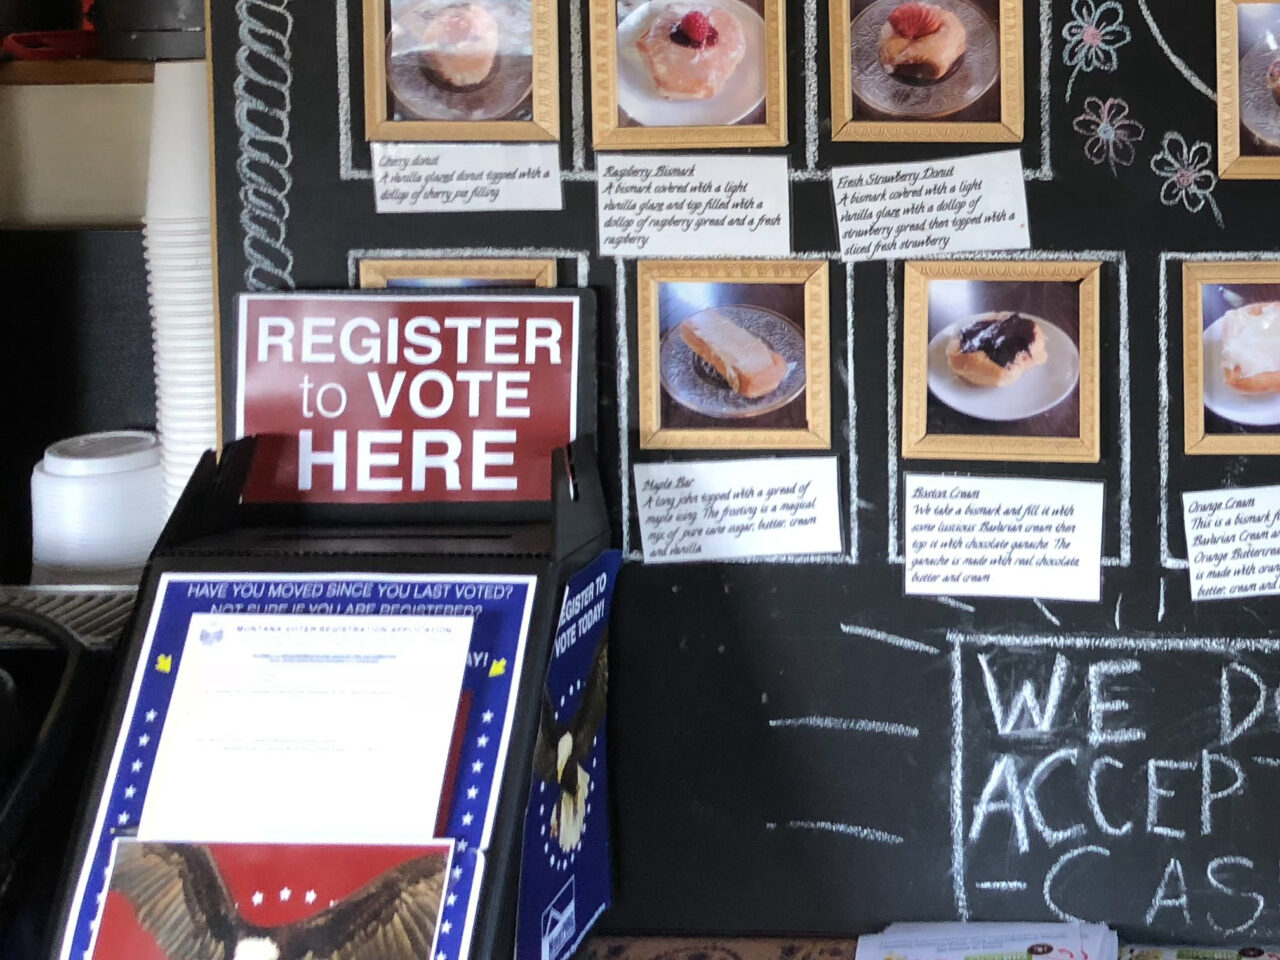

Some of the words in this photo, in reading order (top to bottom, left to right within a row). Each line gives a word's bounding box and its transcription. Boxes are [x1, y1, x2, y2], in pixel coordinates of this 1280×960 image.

[257, 316, 562, 365] REGISTER
[299, 374, 348, 418] to
[367, 369, 531, 419] VOTE
[298, 429, 518, 491] HERE
[188, 583, 228, 599] HAVE
[231, 583, 266, 599] YOU
[267, 583, 324, 598] MOVED
[326, 583, 372, 598] SINCE
[376, 583, 412, 599] YOU
[412, 583, 452, 599] LAST
[453, 583, 514, 600] VOTED?
[560, 581, 595, 627] EGISTER
[555, 623, 577, 658] VOTE
[578, 598, 605, 638] TODAY!
[977, 653, 1145, 746] WE
